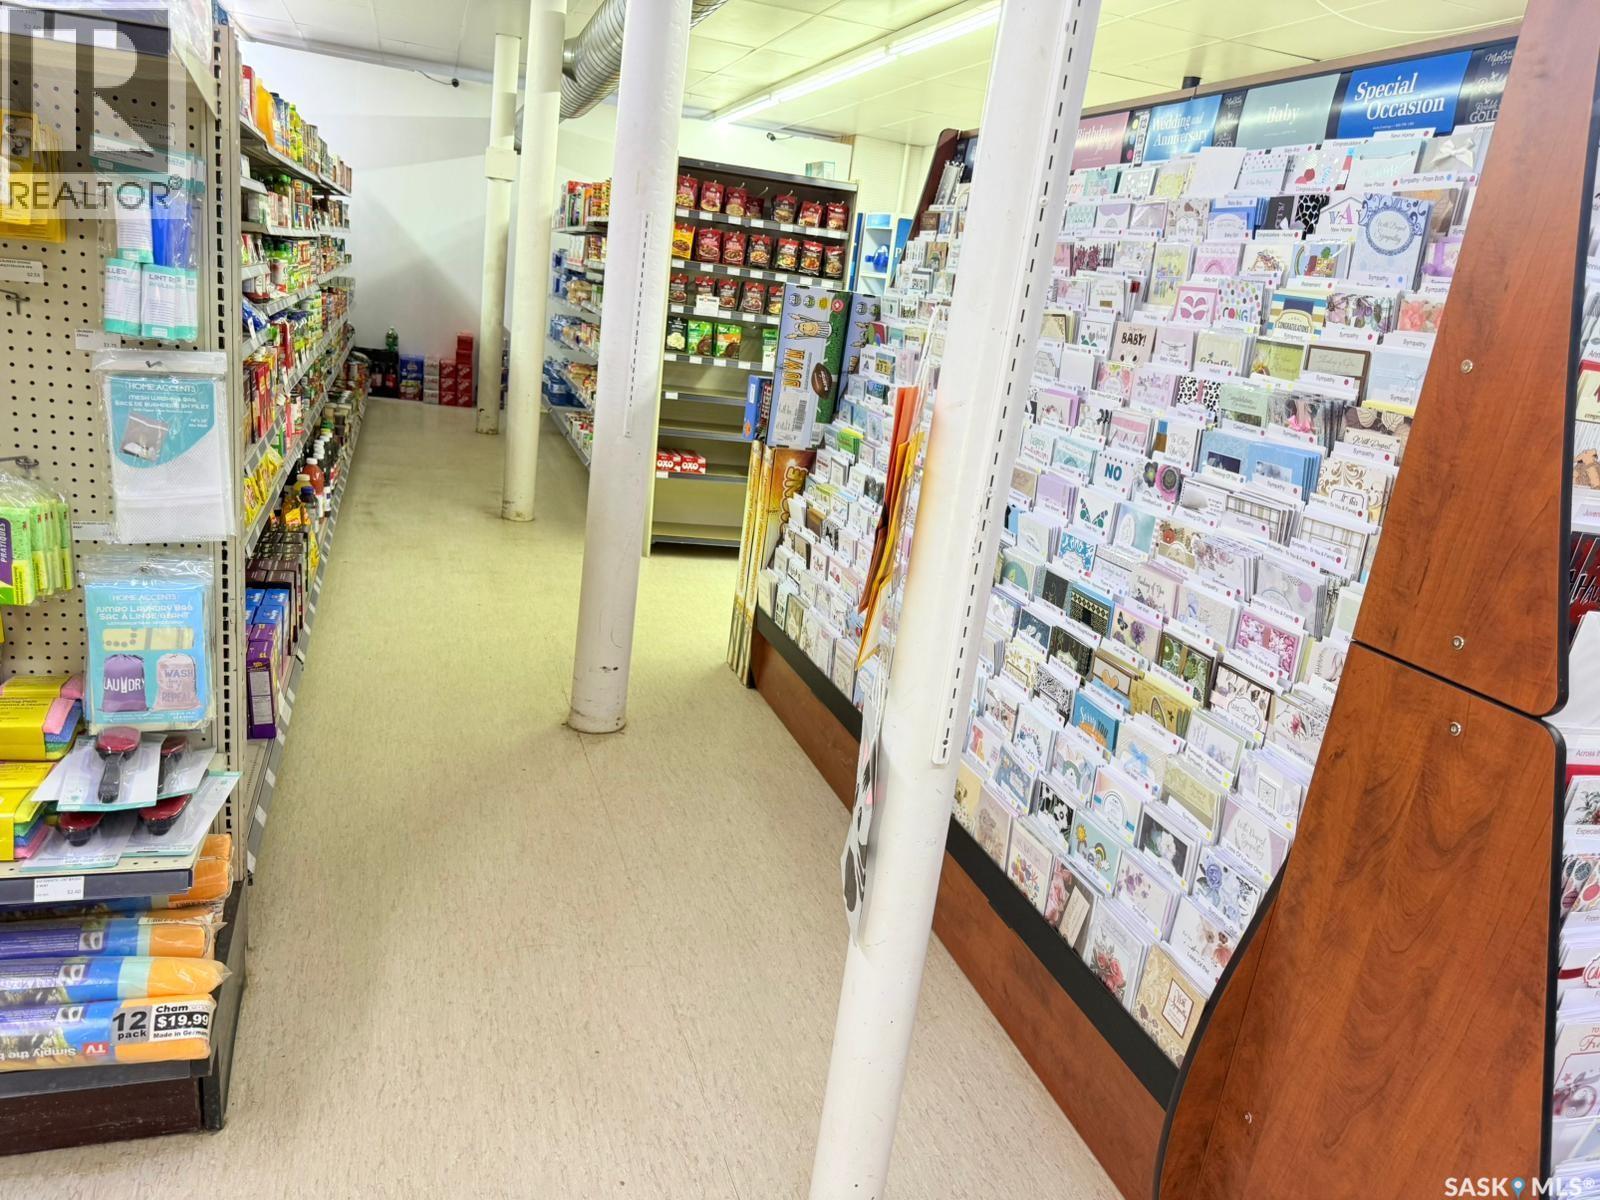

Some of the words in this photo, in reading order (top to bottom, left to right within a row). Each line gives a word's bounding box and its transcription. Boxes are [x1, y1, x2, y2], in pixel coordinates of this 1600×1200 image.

[1354, 72, 1418, 106] Special
[1367, 93, 1445, 121] Occasion
[1266, 103, 1299, 124] Baby
[1152, 112, 1191, 131] Wedding
[1153, 128, 1210, 147] Anniversary
[1121, 331, 1147, 347] BABY!
[656, 459, 674, 469] OXO
[681, 461, 699, 471] OXO
[1104, 462, 1122, 481] NO
[96, 605, 128, 615] JUMBO
[165, 668, 193, 678] WASH
[1080, 705, 1097, 729] Sorry
[1575, 749, 1594, 757] Across
[112, 1011, 147, 1031] 12
[156, 1013, 209, 1028] $19.99
[118, 1030, 147, 1040] pack
[153, 1031, 172, 1039] Made
[9, 1050, 30, 1060] the
[33, 1047, 76, 1057] Simply
[85, 1044, 106, 1054] TV
